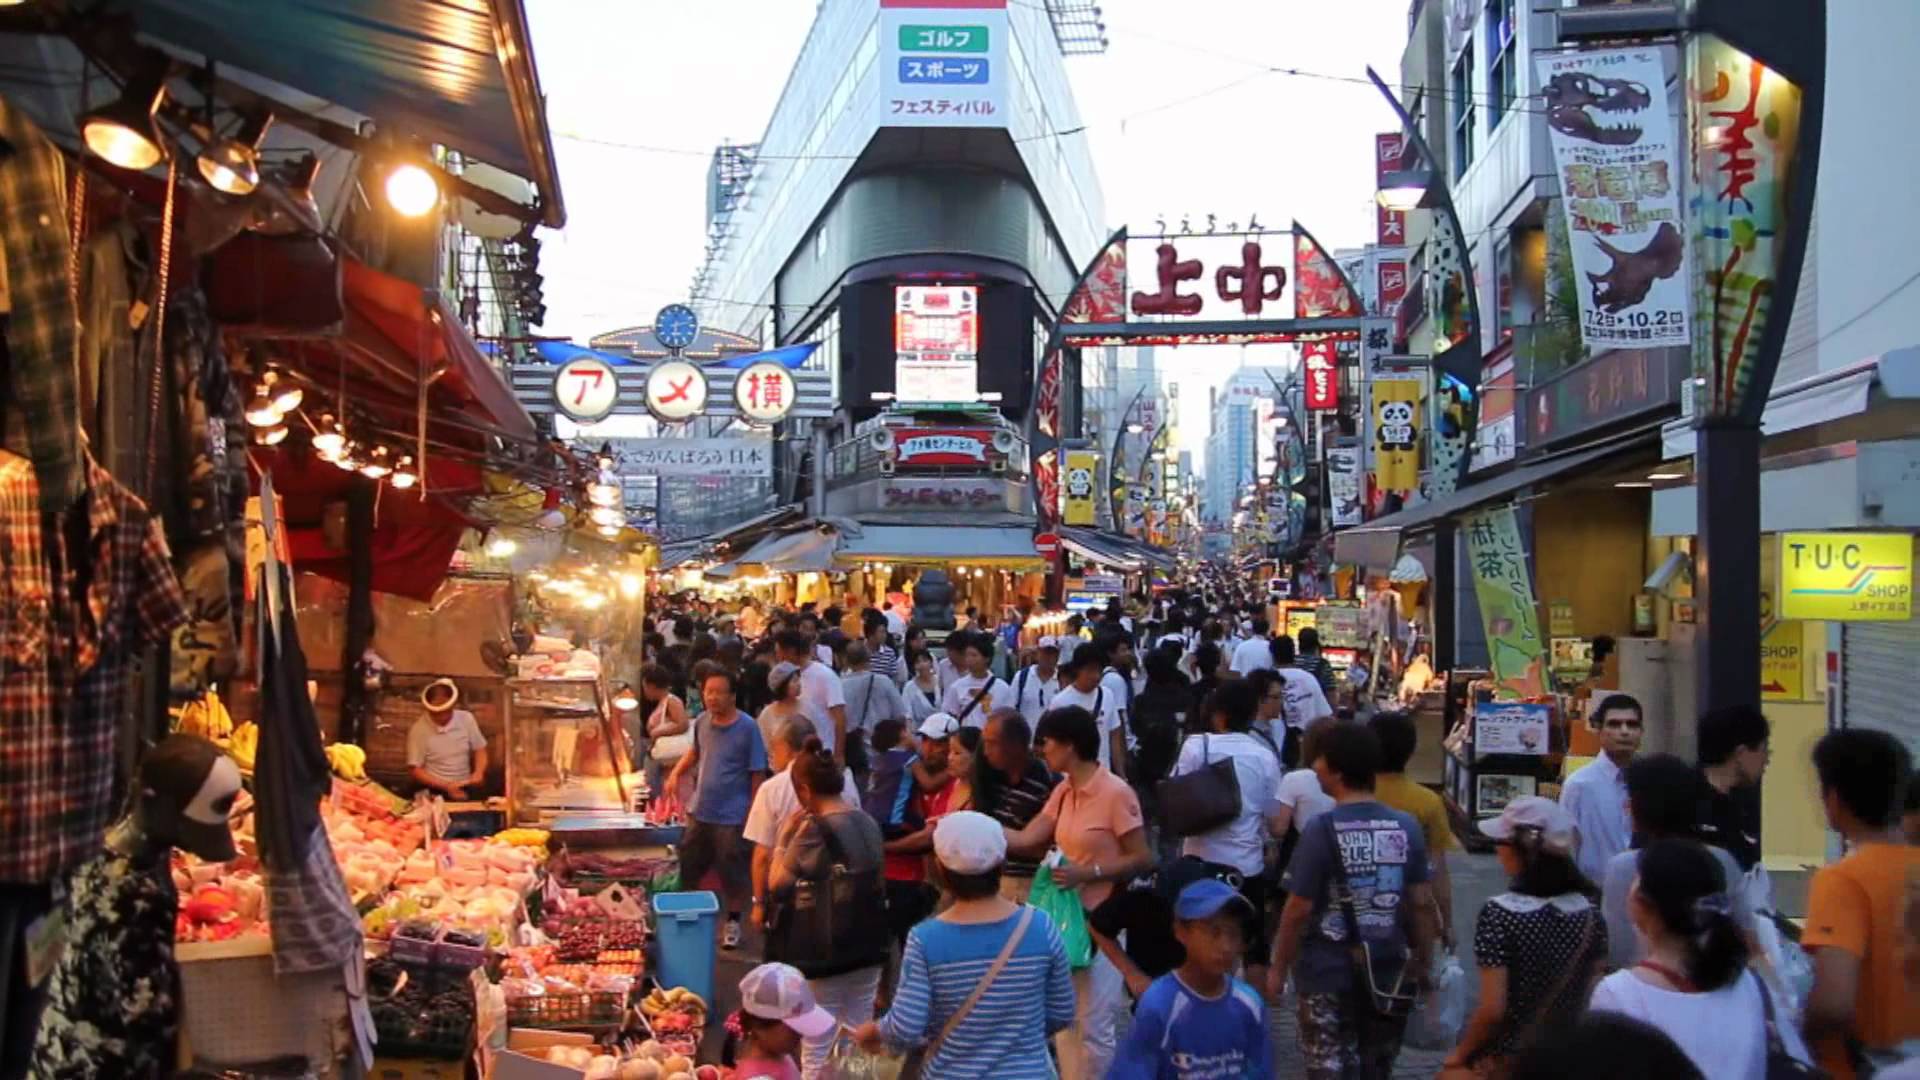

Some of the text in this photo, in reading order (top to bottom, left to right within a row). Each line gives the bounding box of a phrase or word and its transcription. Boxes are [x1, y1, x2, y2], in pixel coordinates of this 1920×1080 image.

[919, 31, 970, 47] ゴルフ
[907, 62, 979, 79] スポーツ
[891, 100, 995, 115] フェスティバル
[1131, 242, 1286, 315] 上中
[569, 368, 783, 409] アメ横
[1867, 584, 1908, 598] SHOP
